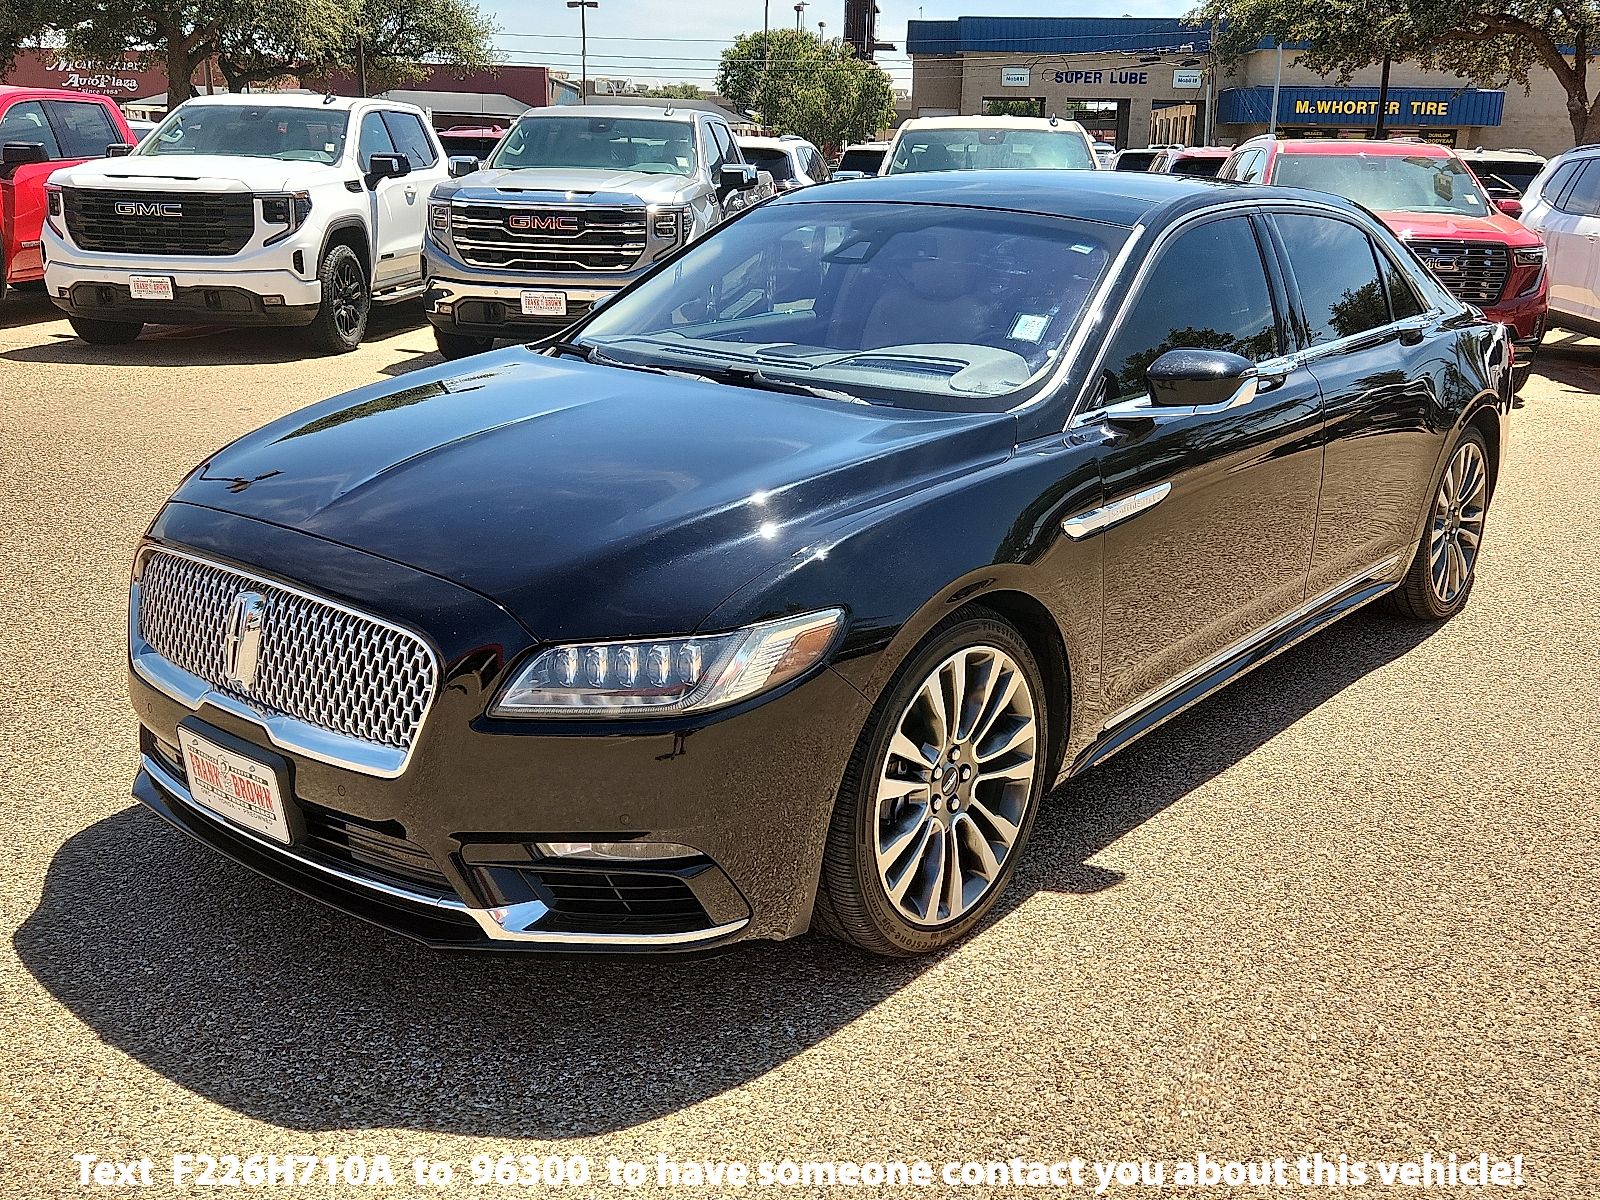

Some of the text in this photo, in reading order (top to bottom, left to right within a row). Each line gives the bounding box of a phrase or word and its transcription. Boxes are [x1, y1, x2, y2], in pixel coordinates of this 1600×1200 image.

[1054, 71, 1148, 84] SUPER LUBE
[1410, 102, 1448, 116] TIRE
[114, 201, 183, 217] GMC
[509, 215, 578, 231] GMC
[189, 752, 224, 790] FRANK
[230, 773, 274, 813] BROWN
